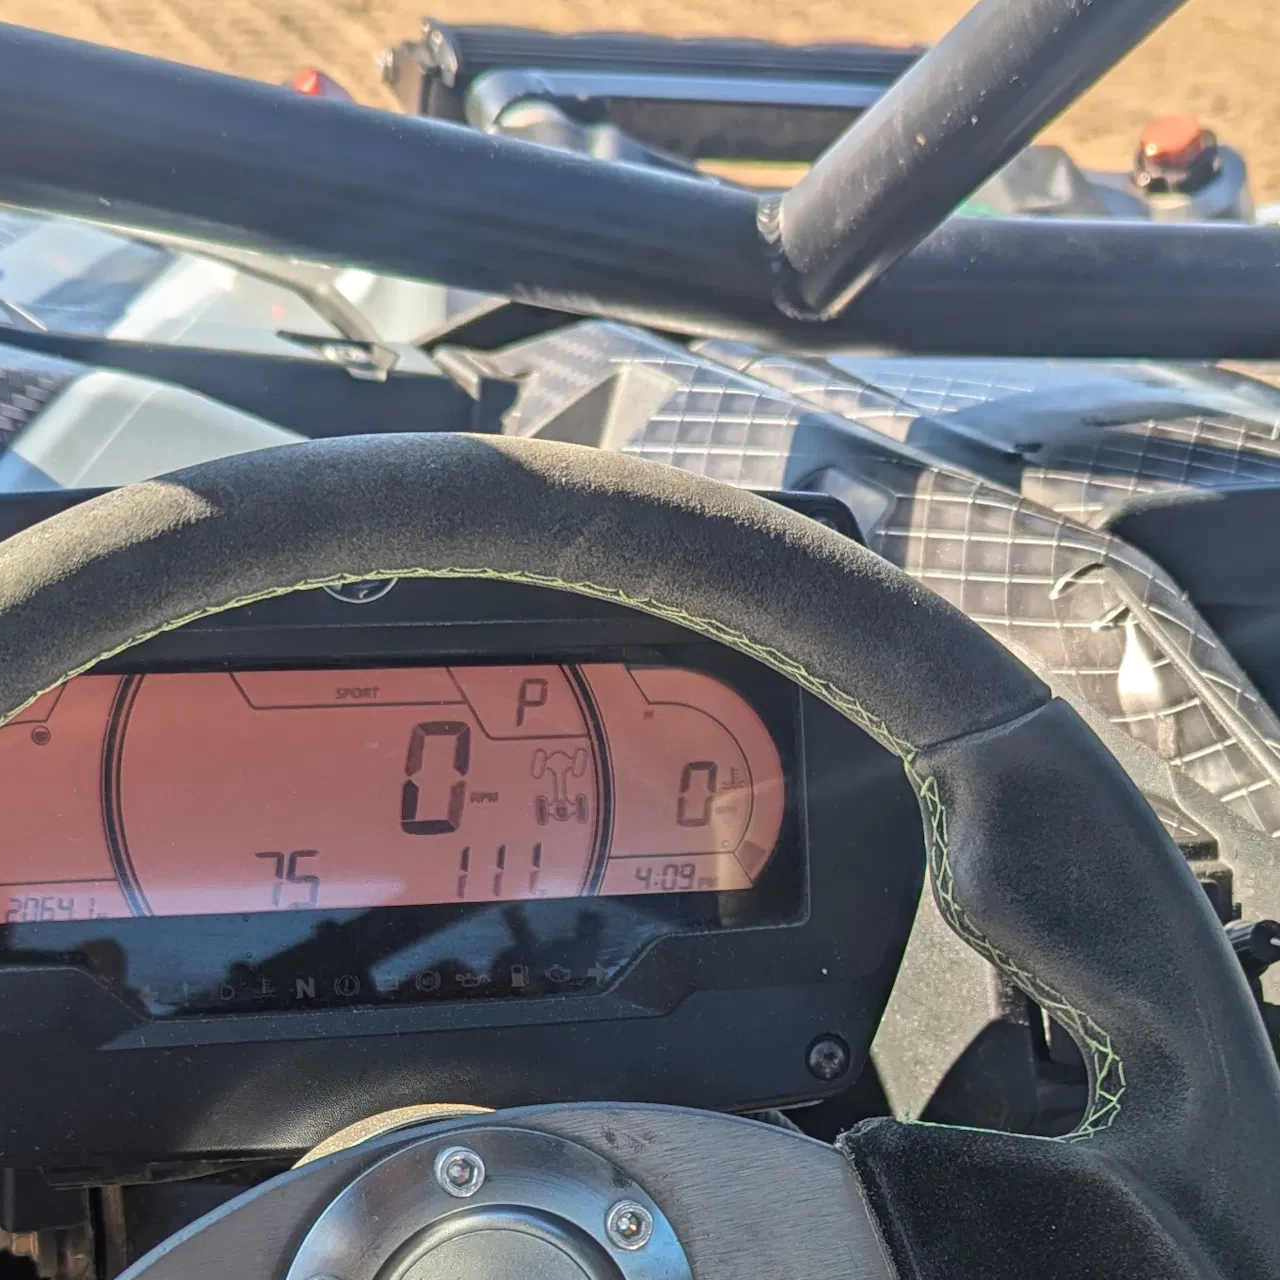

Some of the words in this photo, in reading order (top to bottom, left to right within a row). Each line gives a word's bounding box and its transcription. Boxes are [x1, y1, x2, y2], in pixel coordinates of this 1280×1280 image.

[335, 686, 380, 699] SPORT
[516, 678, 548, 728] P
[401, 720, 471, 835] 0
[676, 761, 718, 827] 0
[254, 850, 320, 909] 75
[457, 842, 542, 898] 111
[635, 863, 696, 890] 4:09
[295, 978, 317, 999] N
